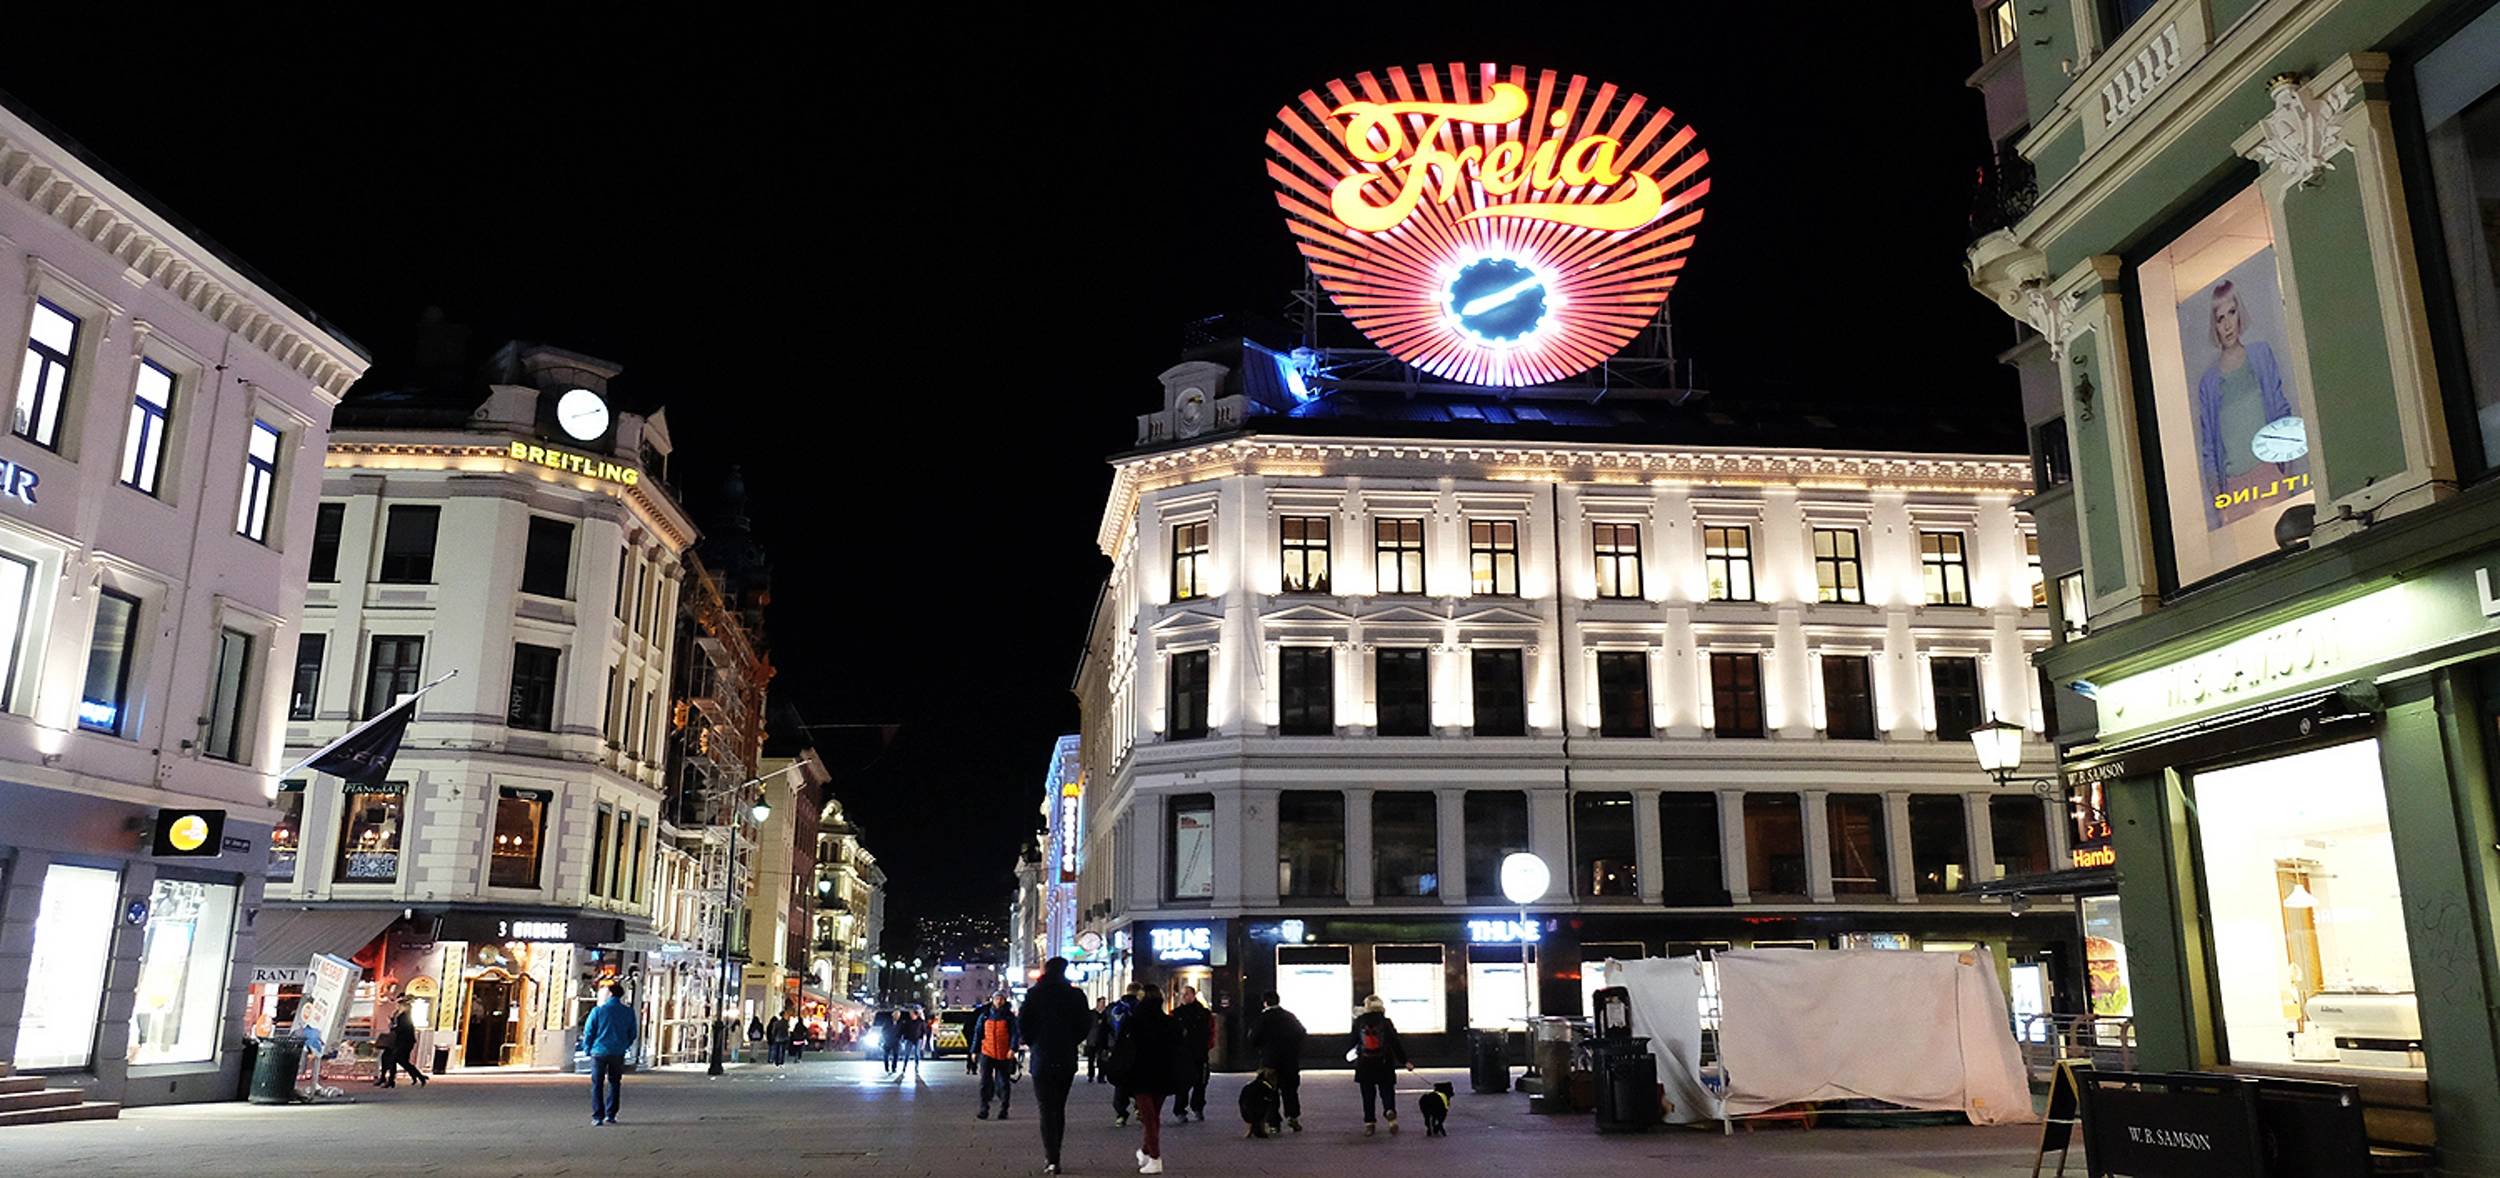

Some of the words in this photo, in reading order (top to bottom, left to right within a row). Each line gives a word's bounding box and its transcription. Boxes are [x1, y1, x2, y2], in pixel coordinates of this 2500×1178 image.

[1327, 82, 1662, 232] Freia
[511, 441, 639, 485] BREITLING
[498, 921, 507, 937] 3
[1150, 928, 1211, 950] THUNE
[1467, 920, 1541, 941] THUNE
[2156, 1129, 2211, 1150] SAMSON
